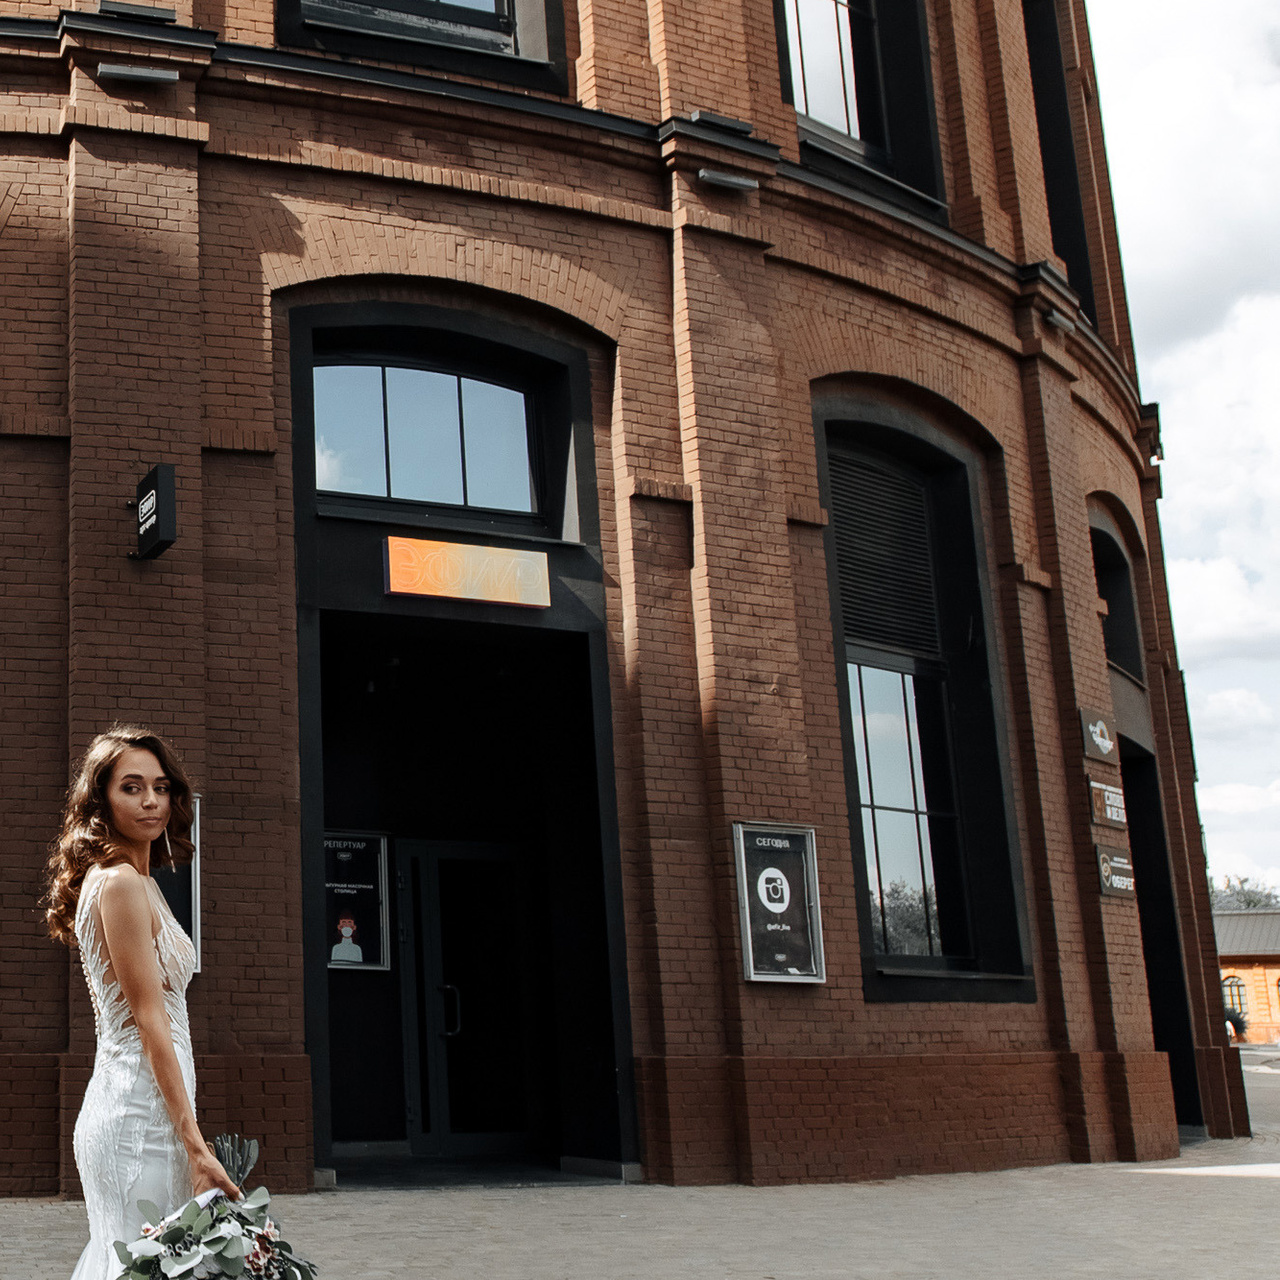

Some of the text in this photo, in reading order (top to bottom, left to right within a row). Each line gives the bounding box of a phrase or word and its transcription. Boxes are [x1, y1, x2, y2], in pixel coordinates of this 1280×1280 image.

[392, 541, 542, 602] ЭФИР
[324, 840, 366, 849] РЕПЕРТУАР
[756, 837, 790, 849] СЕГОДНЯ
